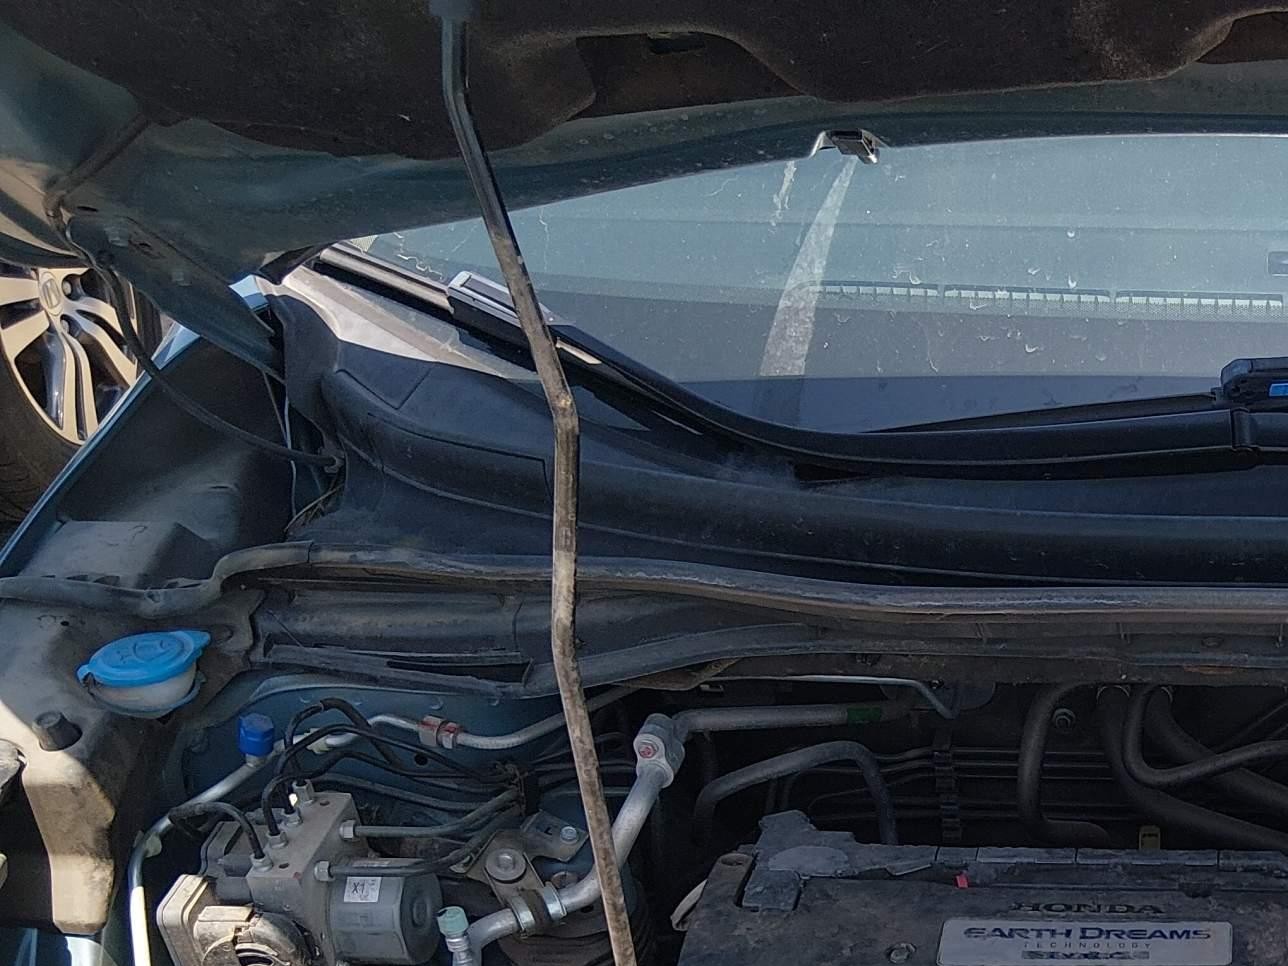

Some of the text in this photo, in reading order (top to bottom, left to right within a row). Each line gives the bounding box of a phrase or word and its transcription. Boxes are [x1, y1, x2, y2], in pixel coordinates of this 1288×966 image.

[1009, 902, 1166, 914] HONDA
[964, 926, 1212, 940] EARTH DREAMS
